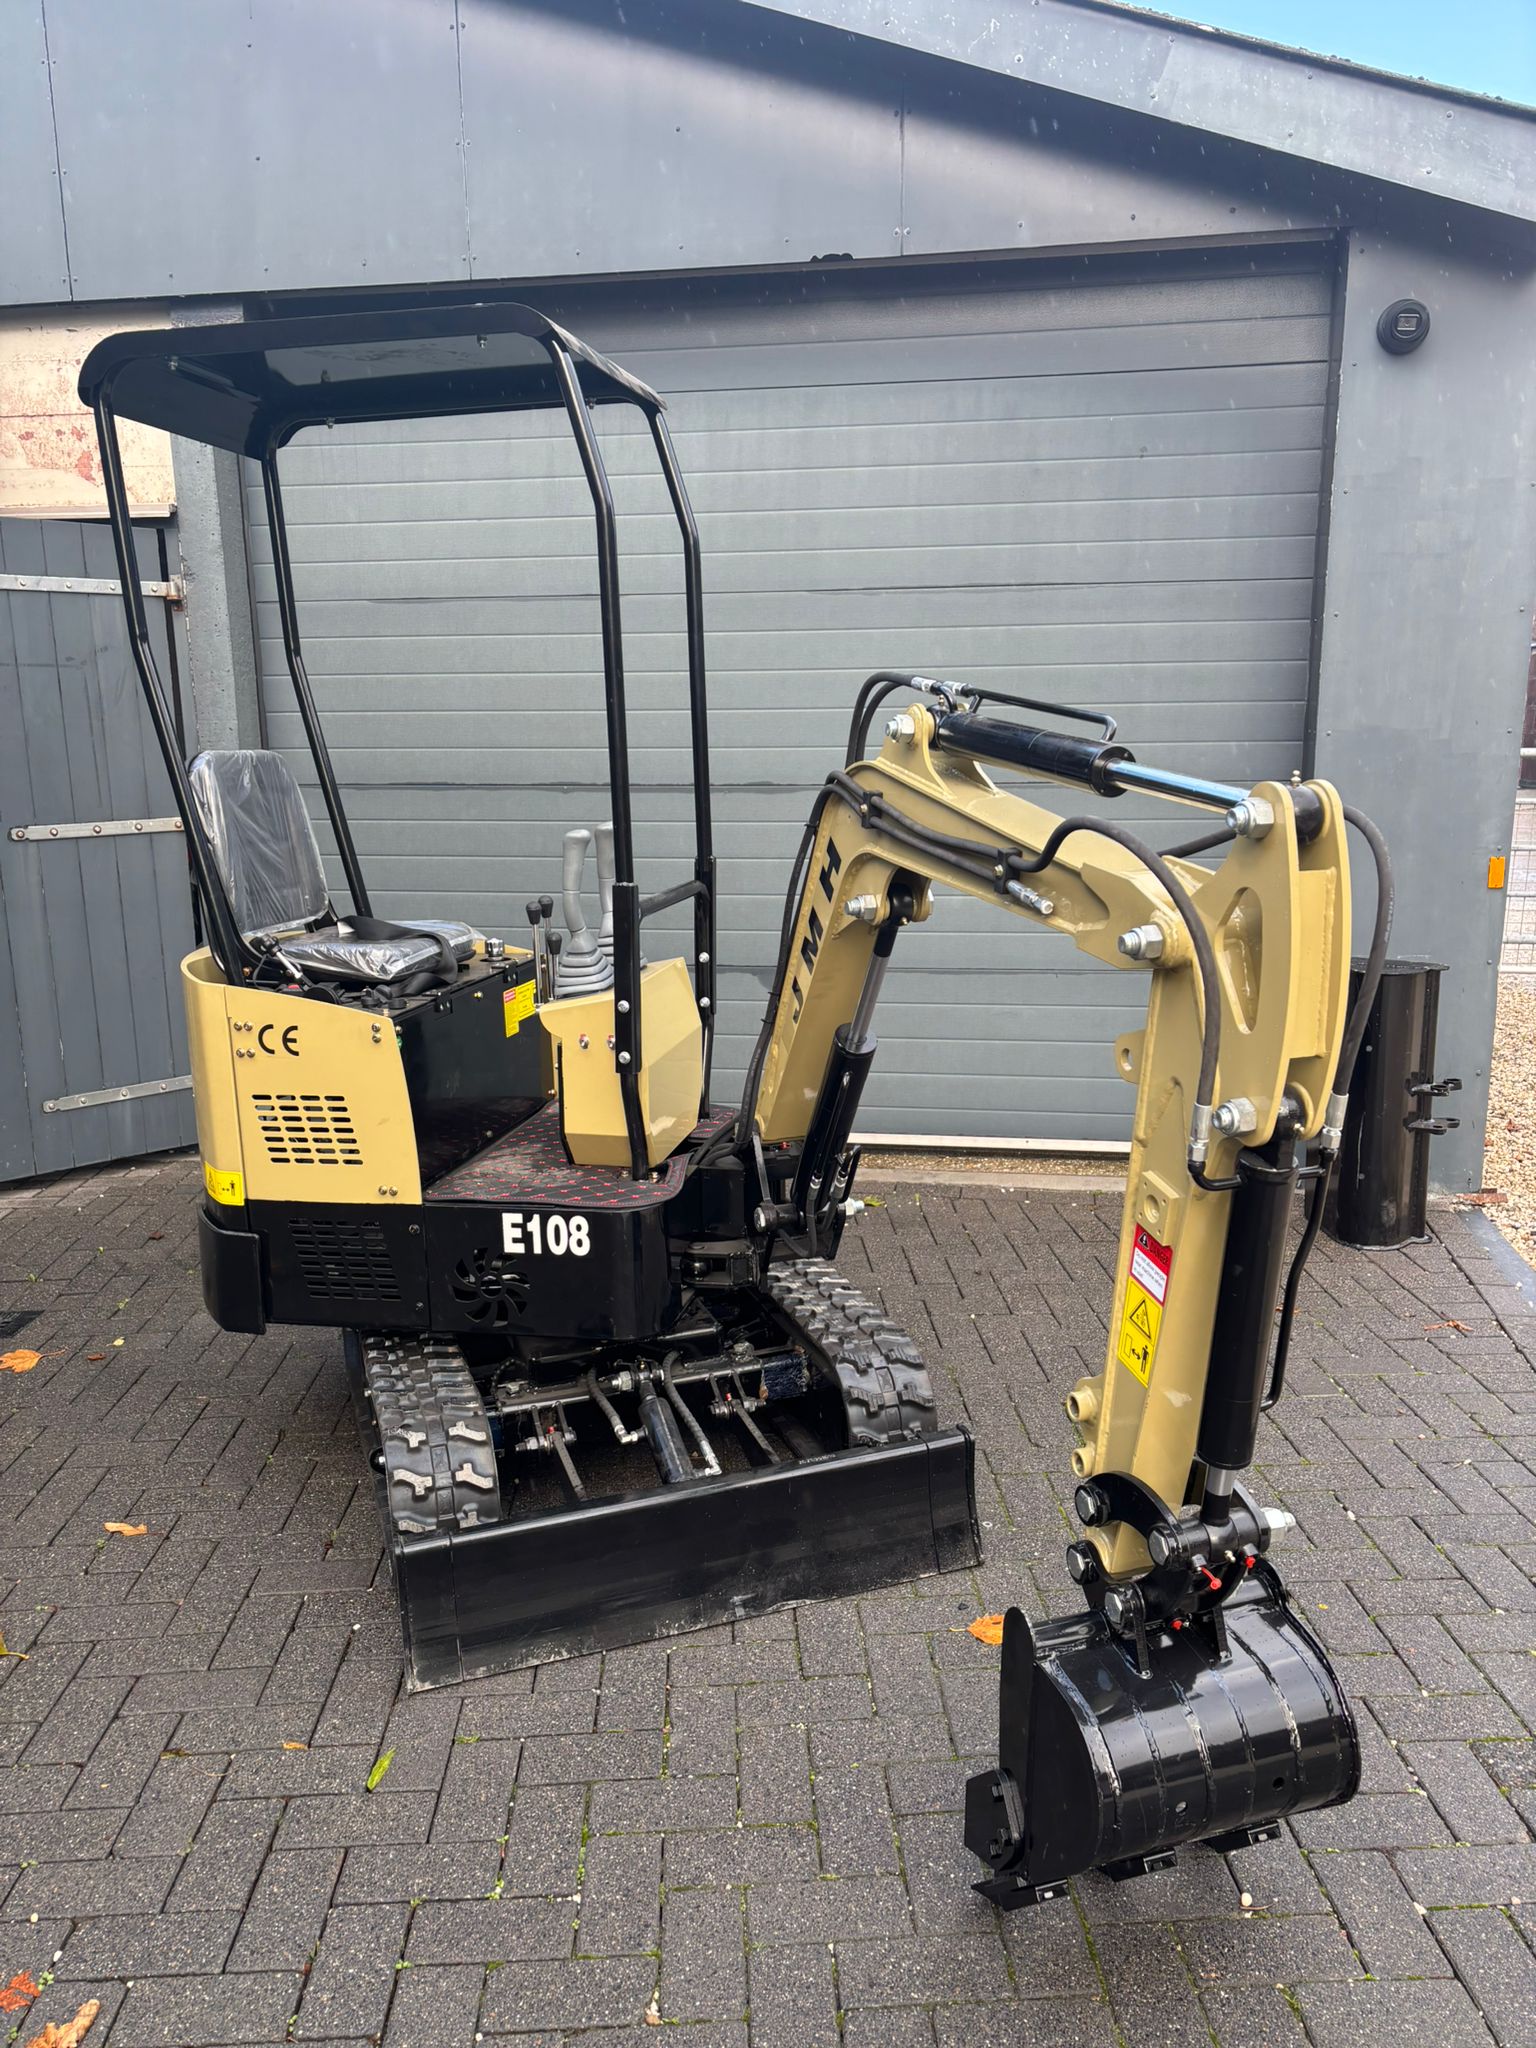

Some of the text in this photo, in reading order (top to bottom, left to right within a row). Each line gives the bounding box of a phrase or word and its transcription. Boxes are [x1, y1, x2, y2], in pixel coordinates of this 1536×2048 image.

[792, 836, 842, 1025] JMH
[257, 1024, 300, 1057] CE
[501, 1212, 591, 1257] E108
